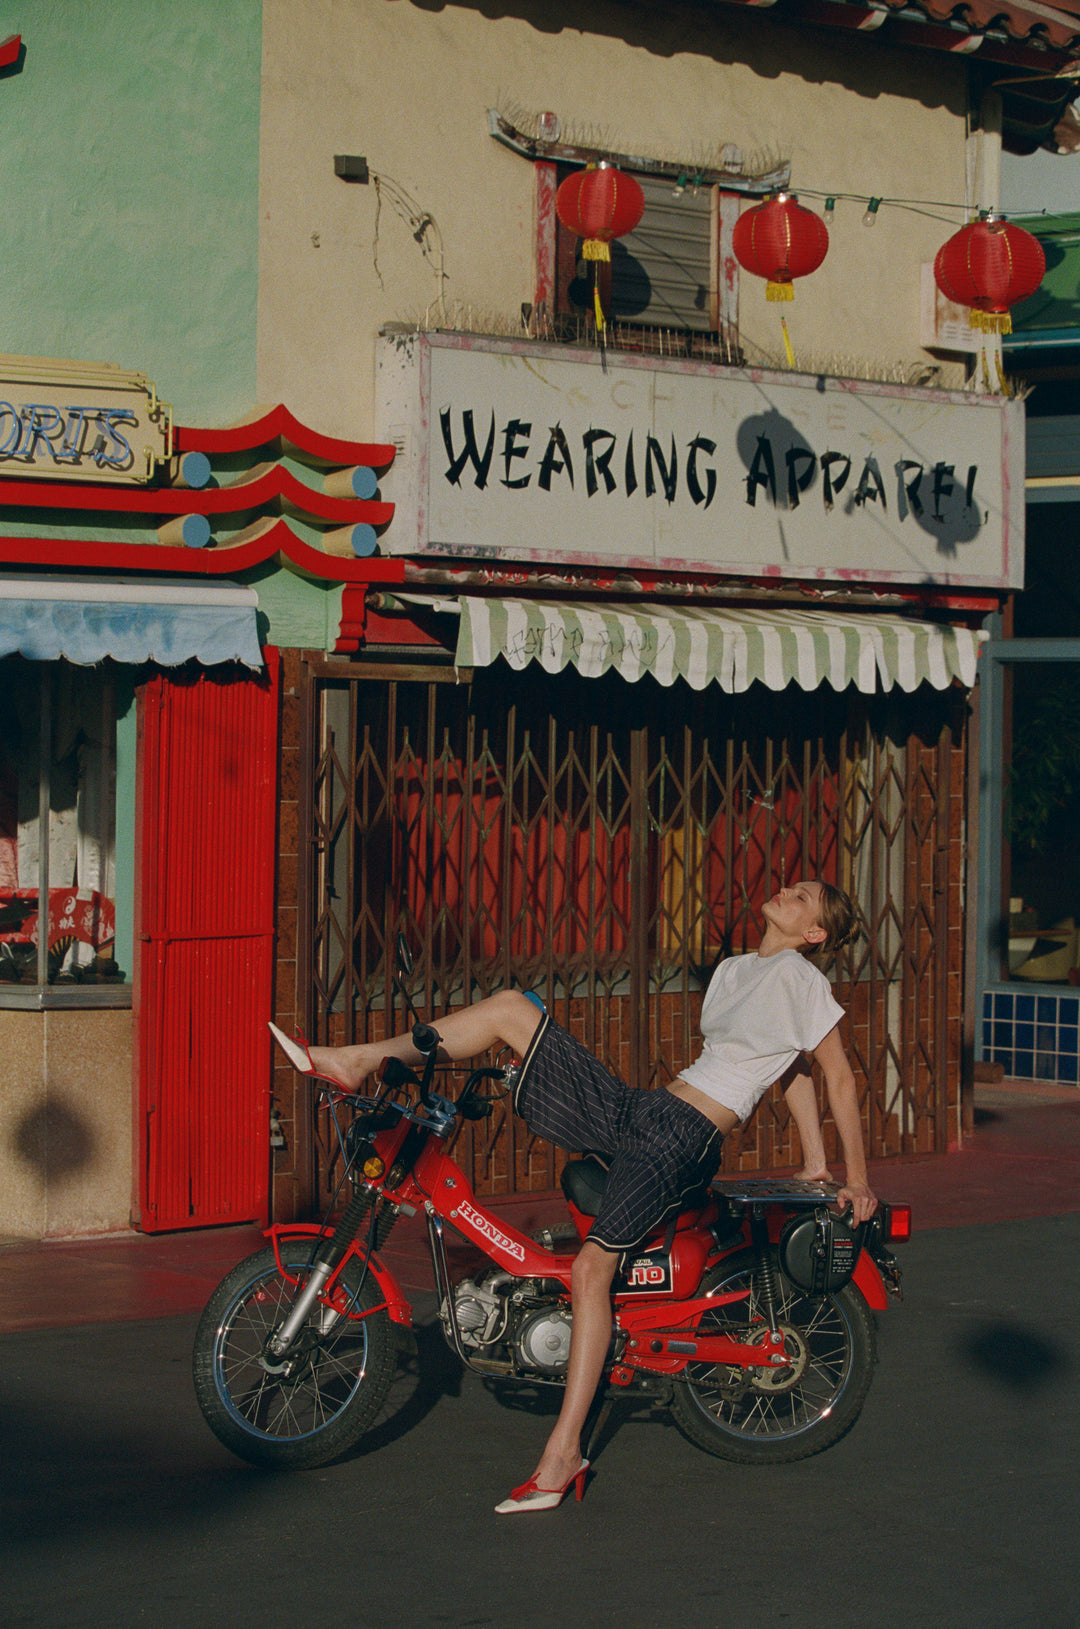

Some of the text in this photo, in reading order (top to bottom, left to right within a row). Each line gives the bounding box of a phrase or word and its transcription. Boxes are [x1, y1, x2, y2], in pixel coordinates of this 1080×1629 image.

[439, 405, 988, 526] WEARING APPAREL
[457, 1200, 525, 1261] HONDA
[626, 1265, 665, 1286] 110
